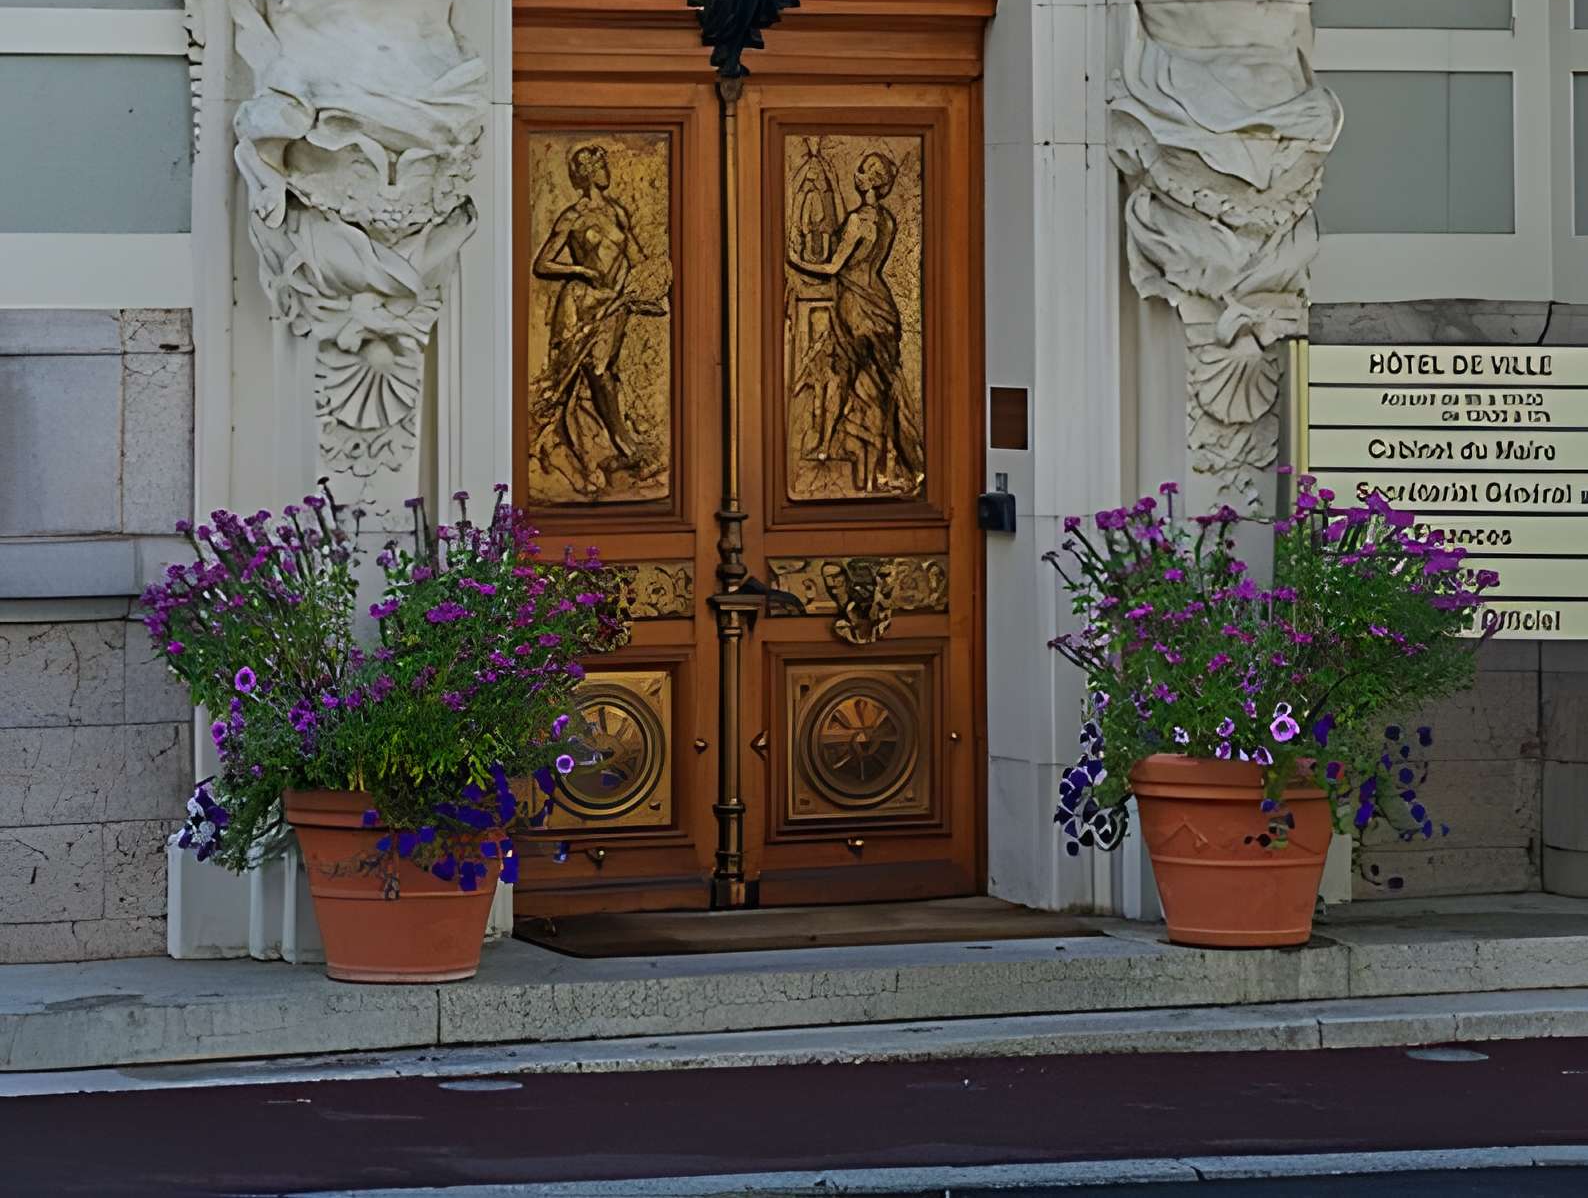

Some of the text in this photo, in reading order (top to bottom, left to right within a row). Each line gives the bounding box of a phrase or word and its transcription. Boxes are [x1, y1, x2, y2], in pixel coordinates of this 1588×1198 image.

[1369, 351, 1553, 376] HÔTEL DE VILLE
